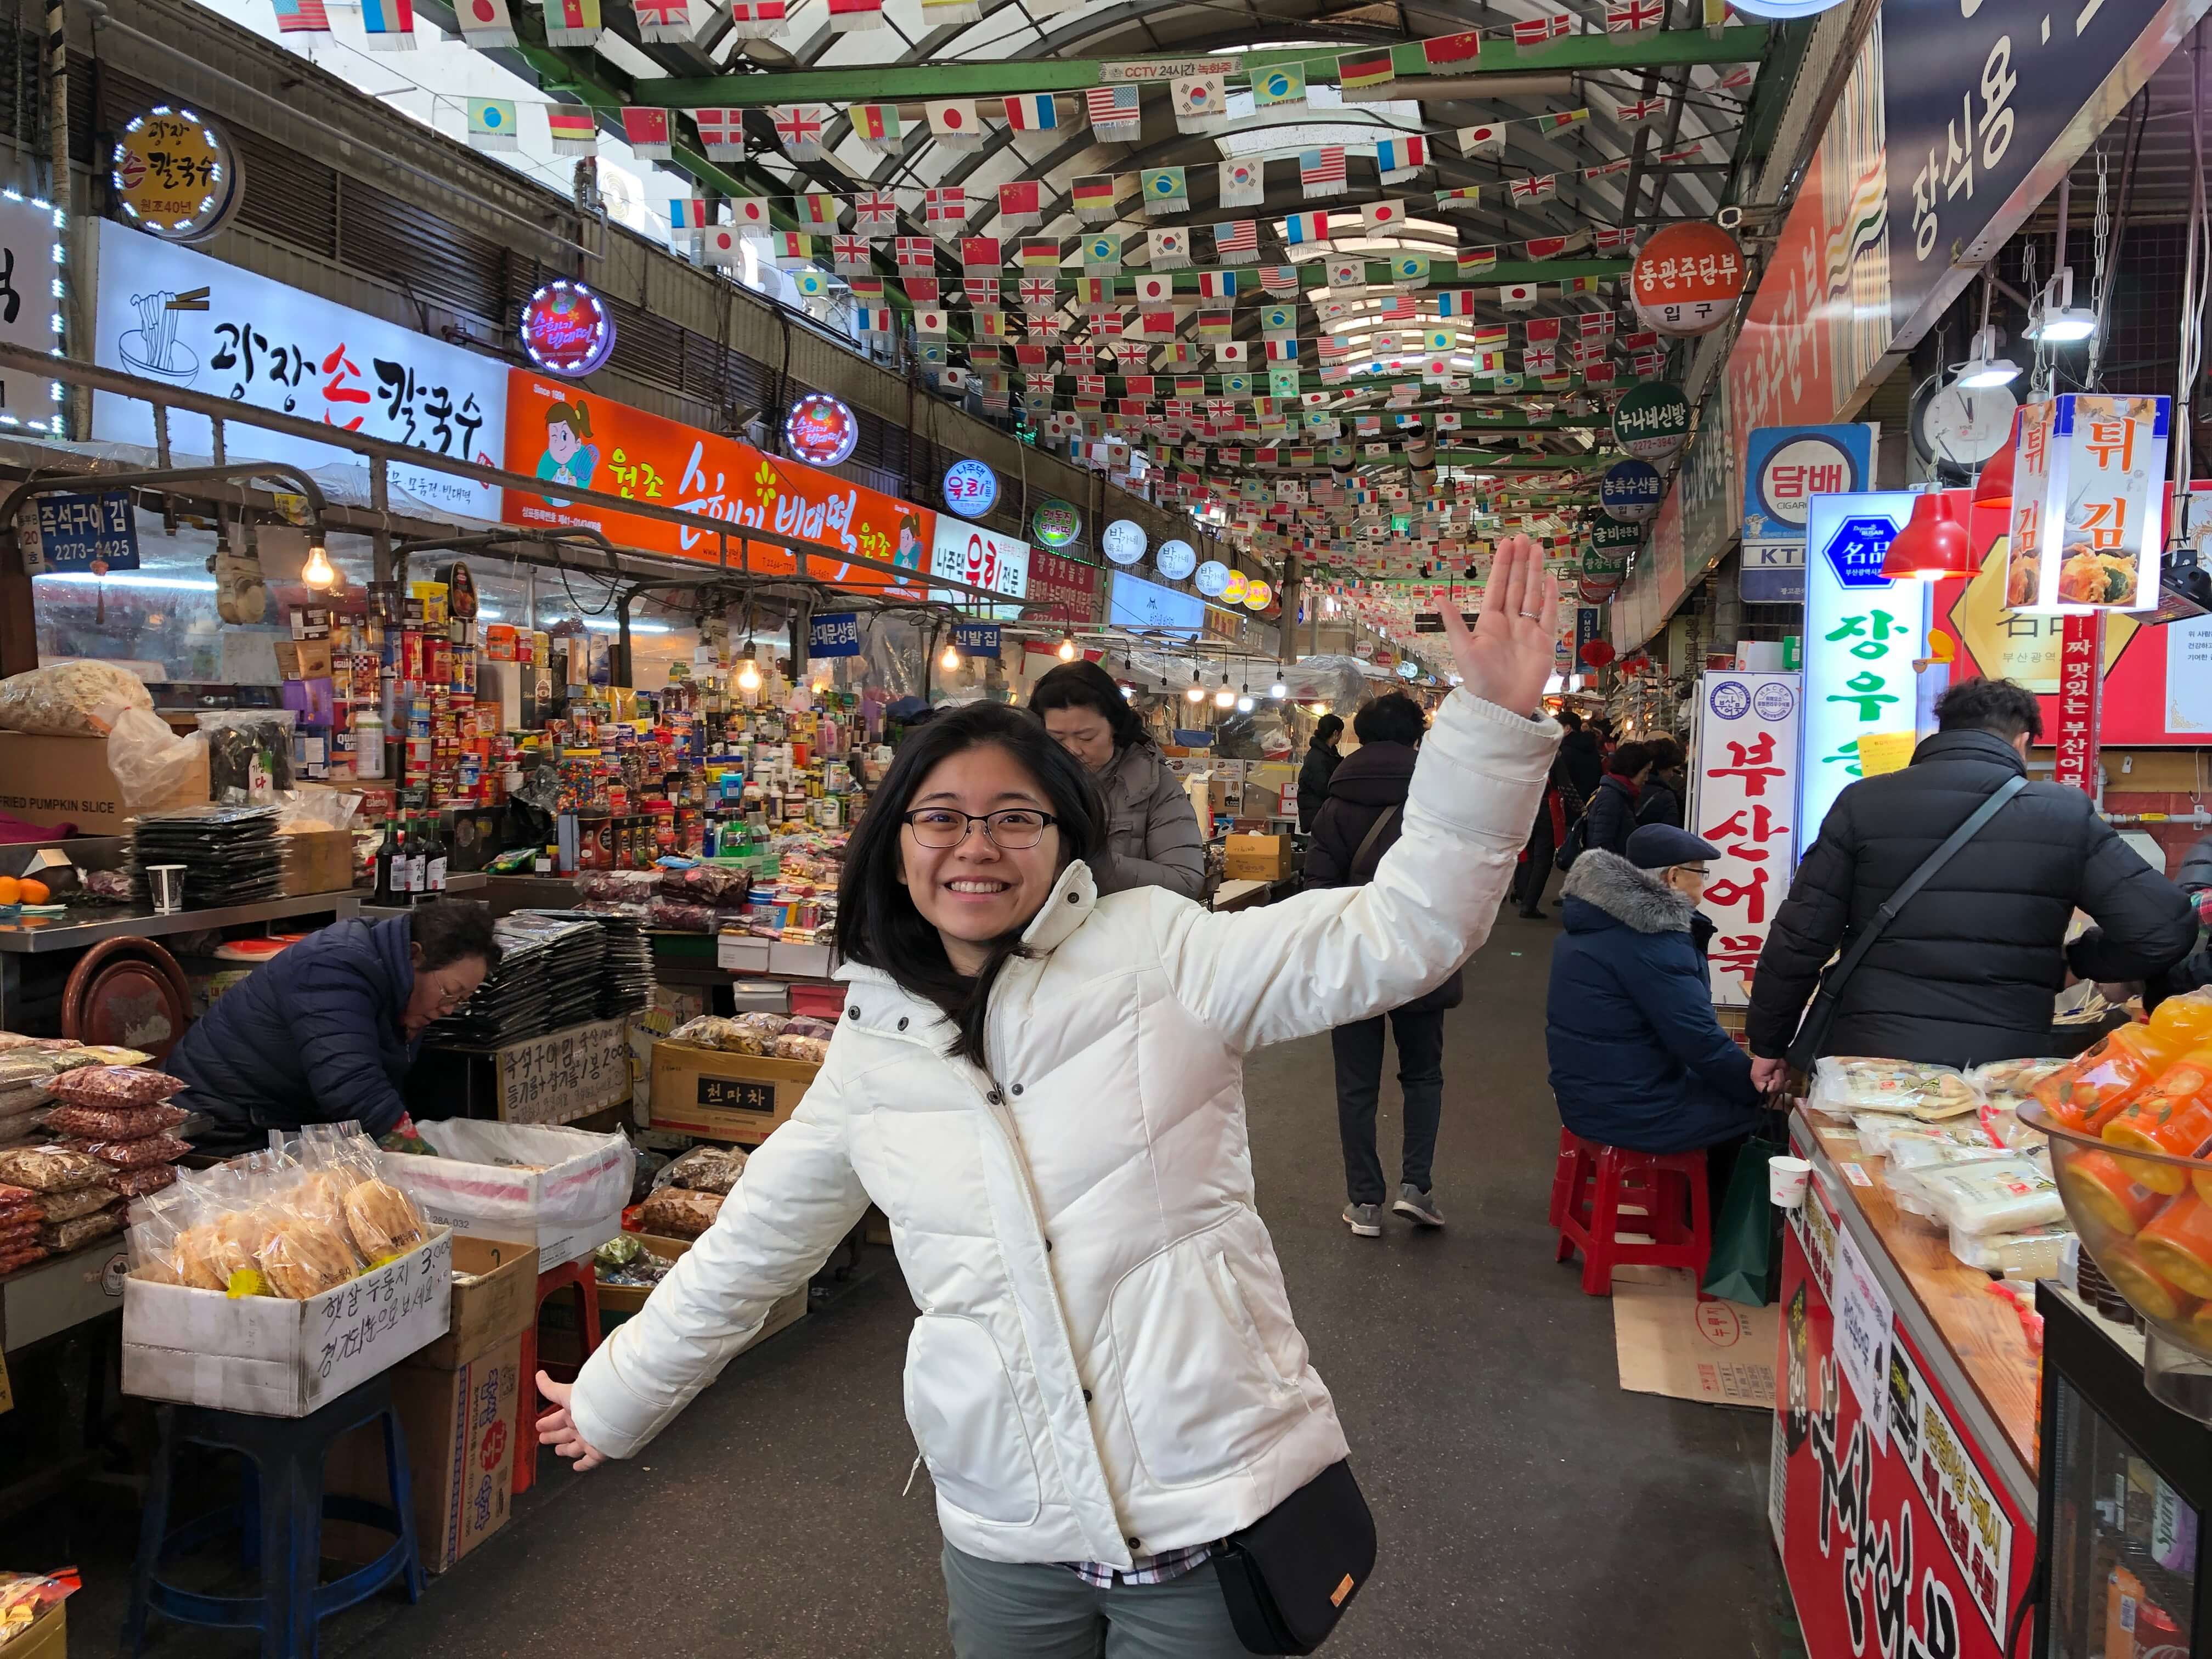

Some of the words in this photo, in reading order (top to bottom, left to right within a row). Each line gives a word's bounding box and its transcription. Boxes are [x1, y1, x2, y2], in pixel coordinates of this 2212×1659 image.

[1125, 66, 1157, 77] CCTV
[1159, 63, 1195, 76] 24시간
[1198, 61, 1232, 75] 녹화중
[148, 120, 190, 145] 광장
[1911, 34, 2017, 262] 장식용
[1639, 253, 1737, 291] 동관주단부
[1664, 303, 1712, 321] 입구
[533, 383, 550, 396] Since
[1618, 402, 1685, 433] 누나네신발
[957, 464, 985, 477] 나주댁
[948, 476, 984, 500] 육회
[1604, 477, 1659, 495] 농축수산물
[1772, 465, 1842, 498] 담배
[2017, 421, 2047, 551] 튀김
[2079, 416, 2137, 551] 튀김
[607, 448, 663, 498] 원조
[859, 522, 890, 560] 원조
[1618, 505, 1644, 515] 입구
[41, 503, 104, 537] 즉석구이
[1110, 527, 1138, 545] 박가네
[1594, 525, 1618, 543] 굴비
[55, 540, 129, 561] 2273-2425
[1107, 544, 1123, 554] 육회
[1163, 547, 1189, 563] 박가네
[1842, 541, 1890, 565] 名品
[937, 548, 965, 582] 나주댁
[1003, 566, 1019, 594] 전문
[1201, 567, 1224, 581] 박가네
[956, 631, 997, 647] 신발집
[1760, 686, 1789, 698] HACCP
[2063, 662, 2092, 714] 맛있는
[29, 798, 79, 812] PUMPKIN
[82, 801, 115, 814] SLICE
[366, 1261, 409, 1302] 누룽지
